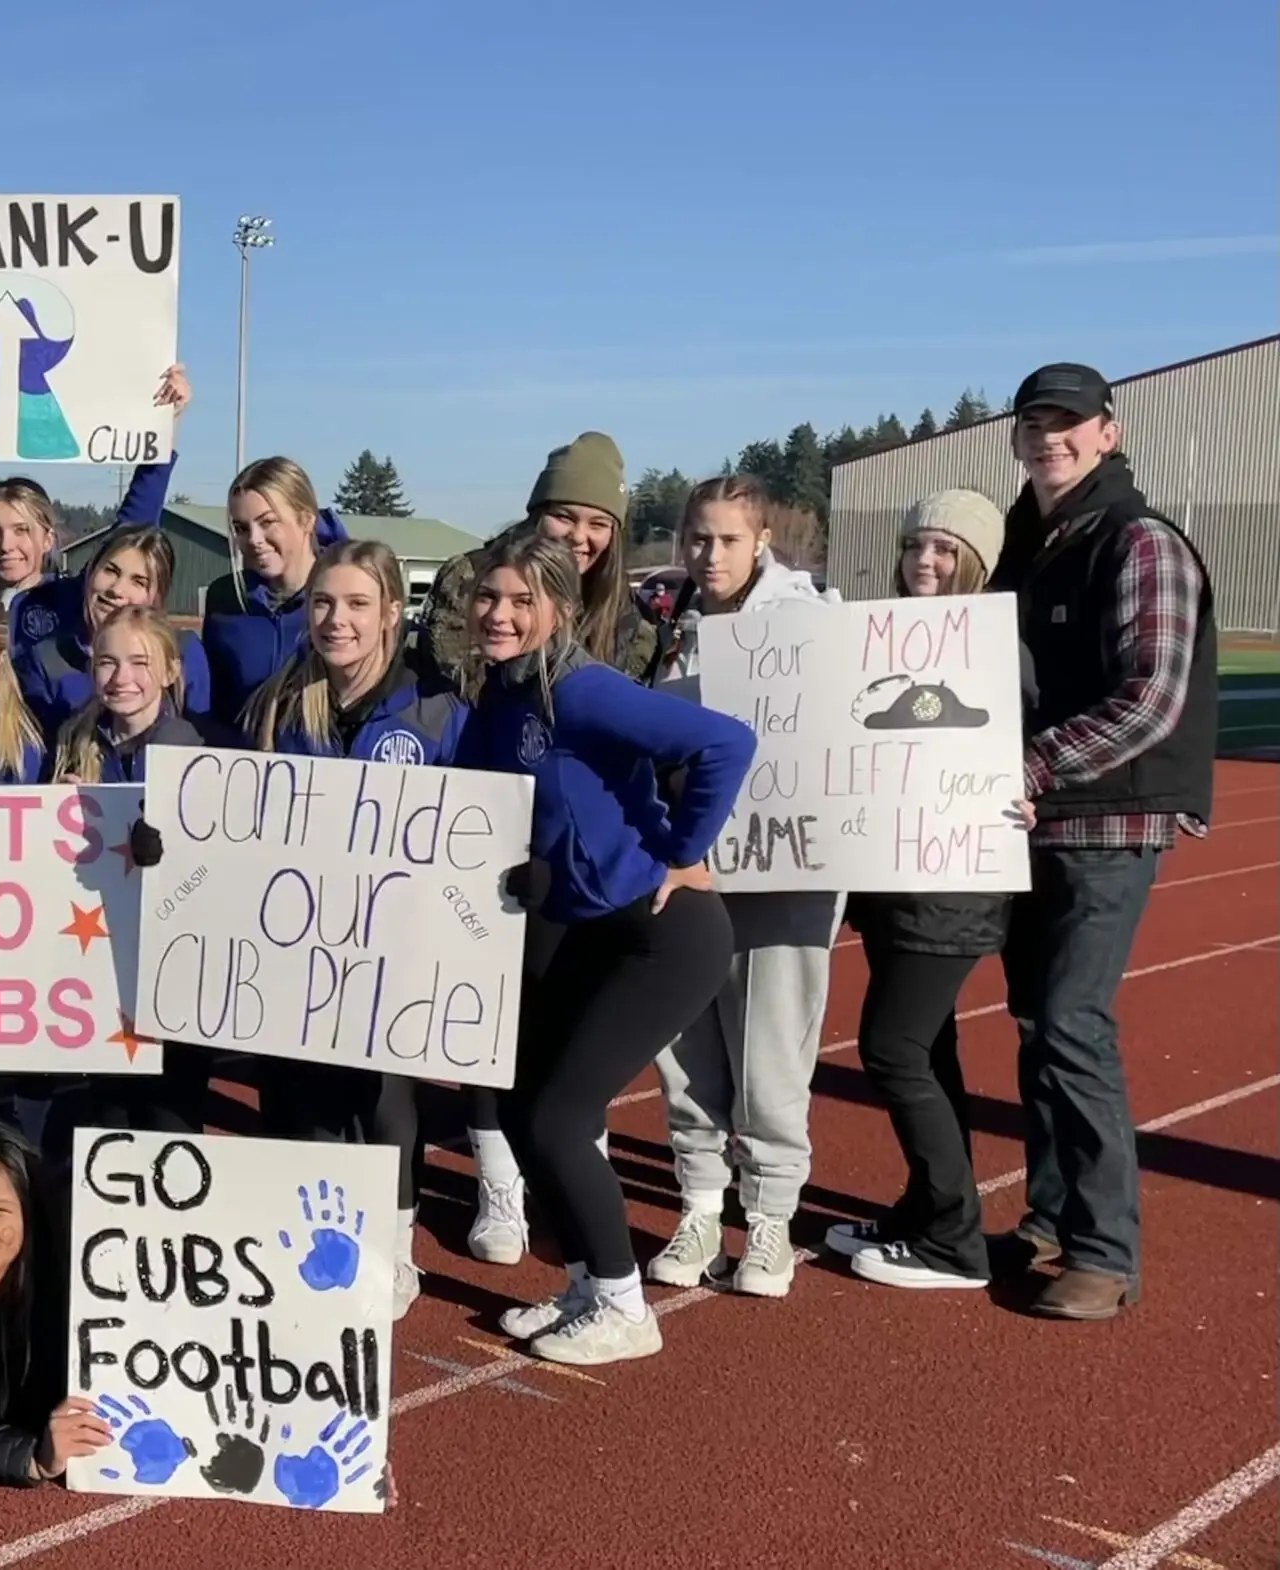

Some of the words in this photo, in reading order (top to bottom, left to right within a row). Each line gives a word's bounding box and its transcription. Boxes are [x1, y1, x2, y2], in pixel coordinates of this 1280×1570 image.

[87, 425, 160, 463] CLUB
[862, 606, 970, 673] MOM
[823, 740, 923, 797] LEFT
[711, 811, 827, 875] GAME
[840, 806, 869, 837] at
[894, 806, 1008, 877] HOME
[153, 933, 264, 1040] CUB
[84, 1132, 212, 1211] GO
[81, 1228, 276, 1308] CUBS
[77, 1317, 380, 1421] Football
